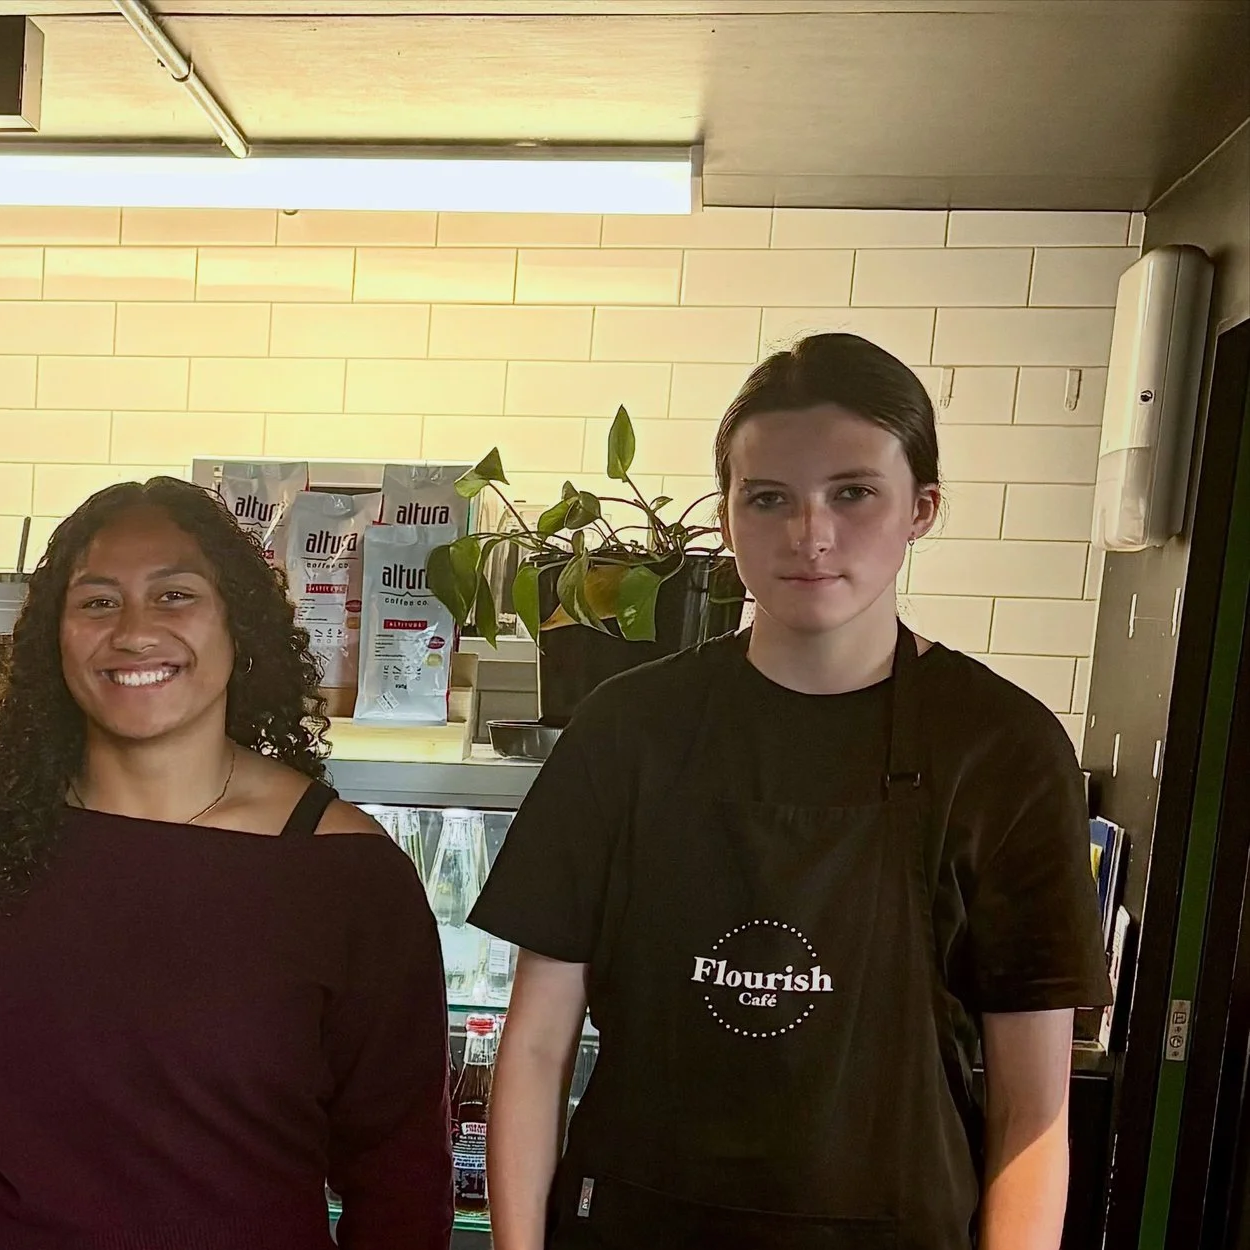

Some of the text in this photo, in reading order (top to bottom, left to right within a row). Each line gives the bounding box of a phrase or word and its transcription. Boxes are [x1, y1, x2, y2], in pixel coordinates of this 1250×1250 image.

[234, 494, 284, 522] altur
[397, 503, 449, 525] altura
[382, 563, 431, 590] altur
[384, 597, 414, 606] coffee
[690, 956, 834, 992] Flourish
[738, 992, 777, 1008] Café
